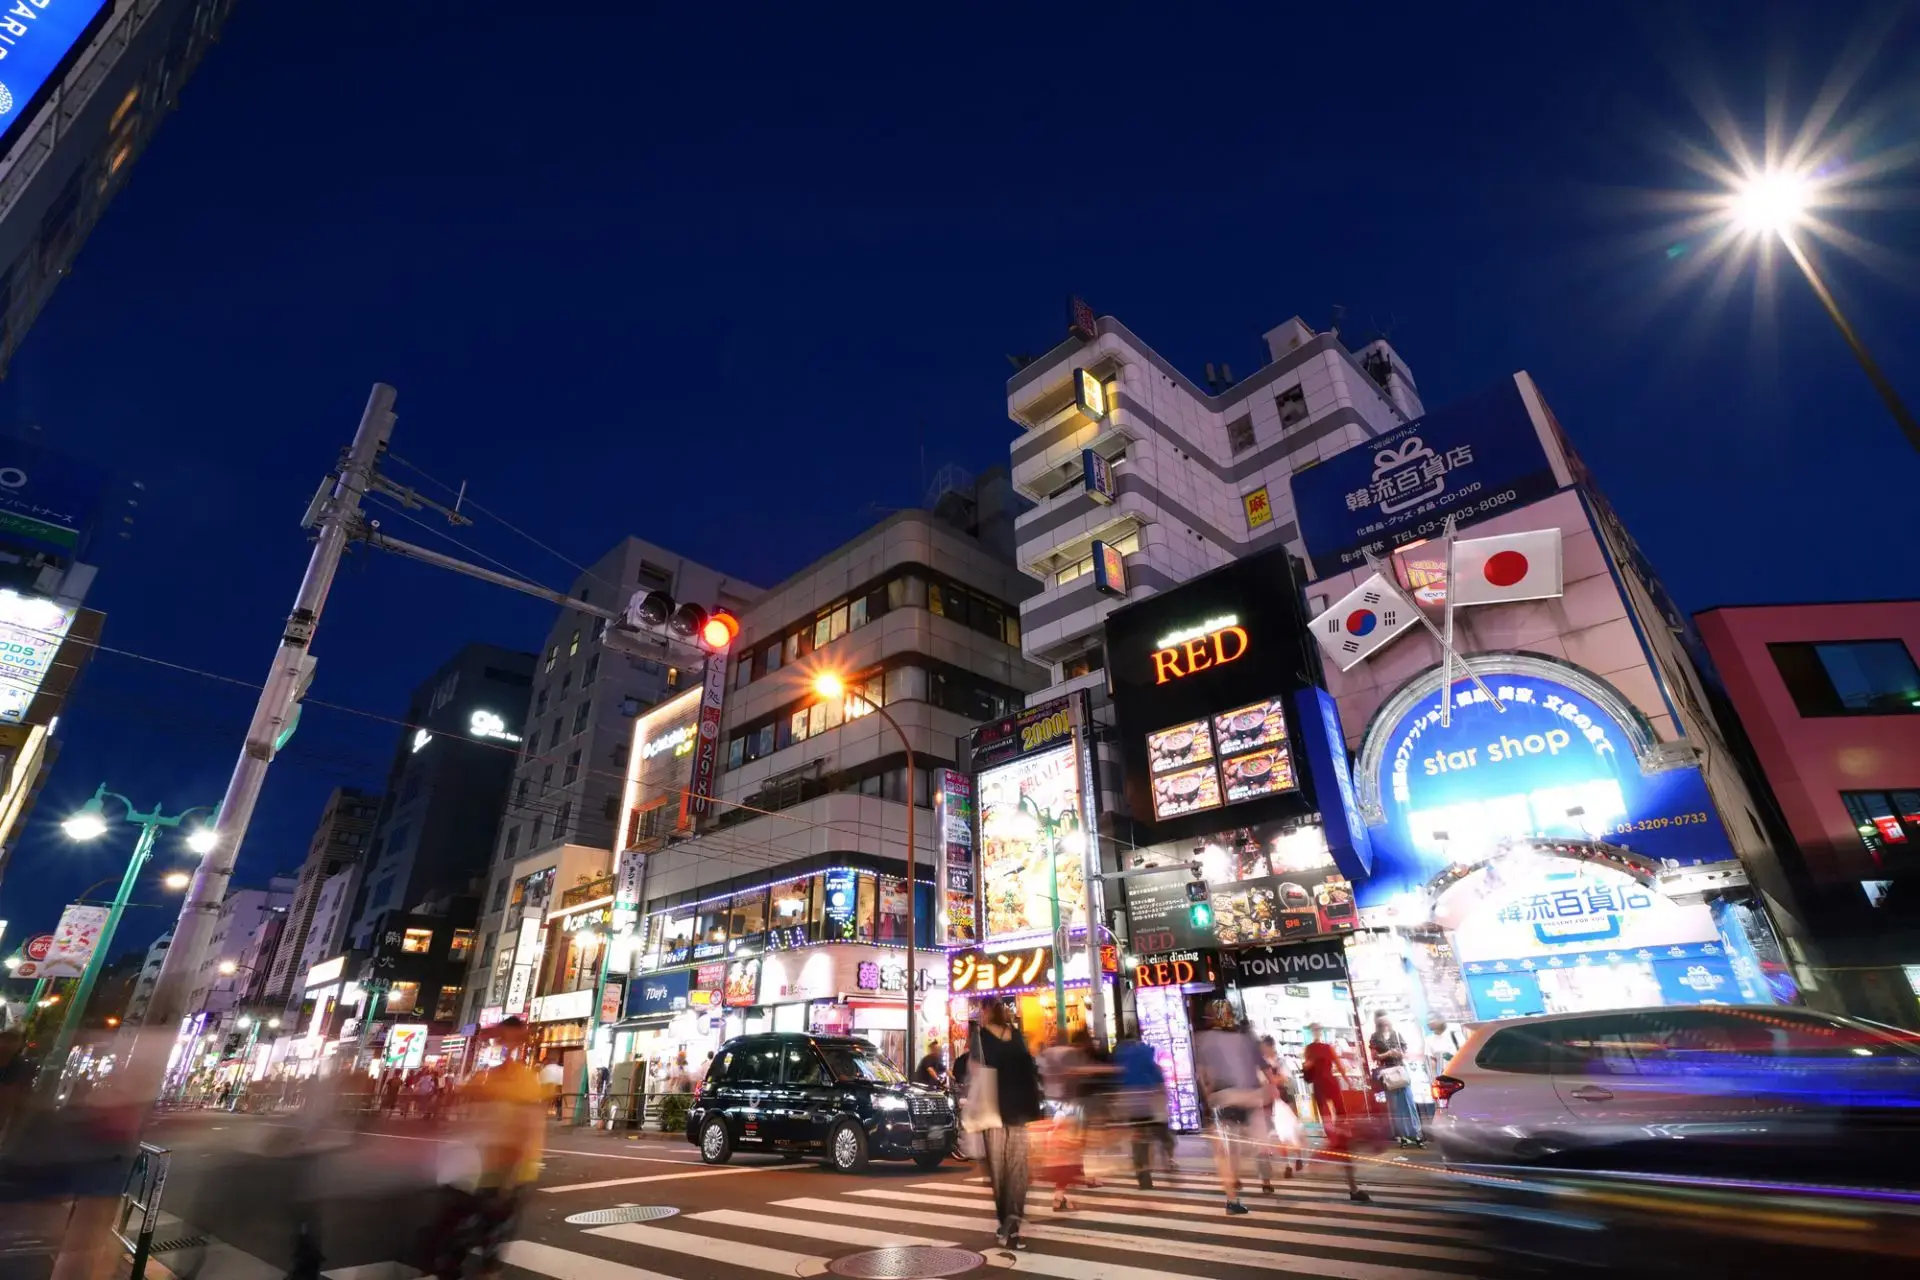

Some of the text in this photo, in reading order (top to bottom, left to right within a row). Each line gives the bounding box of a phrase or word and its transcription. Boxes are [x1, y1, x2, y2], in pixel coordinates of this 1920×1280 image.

[1344, 444, 1475, 512] 韓流百貨店
[1392, 530, 1417, 545] TEL
[1151, 626, 1248, 685] RED
[1423, 729, 1570, 776] star shop
[695, 743, 712, 813] 2980
[1616, 812, 1708, 834] 03-3209-0733
[1498, 884, 1652, 924] 韓流百貨店
[1133, 931, 1176, 955] RED
[1169, 950, 1199, 963] dining
[952, 947, 1045, 992] ジョンノ
[1135, 960, 1194, 987] RED
[1240, 951, 1346, 977] TONYMOLY
[646, 986, 668, 1001] 7Day's
